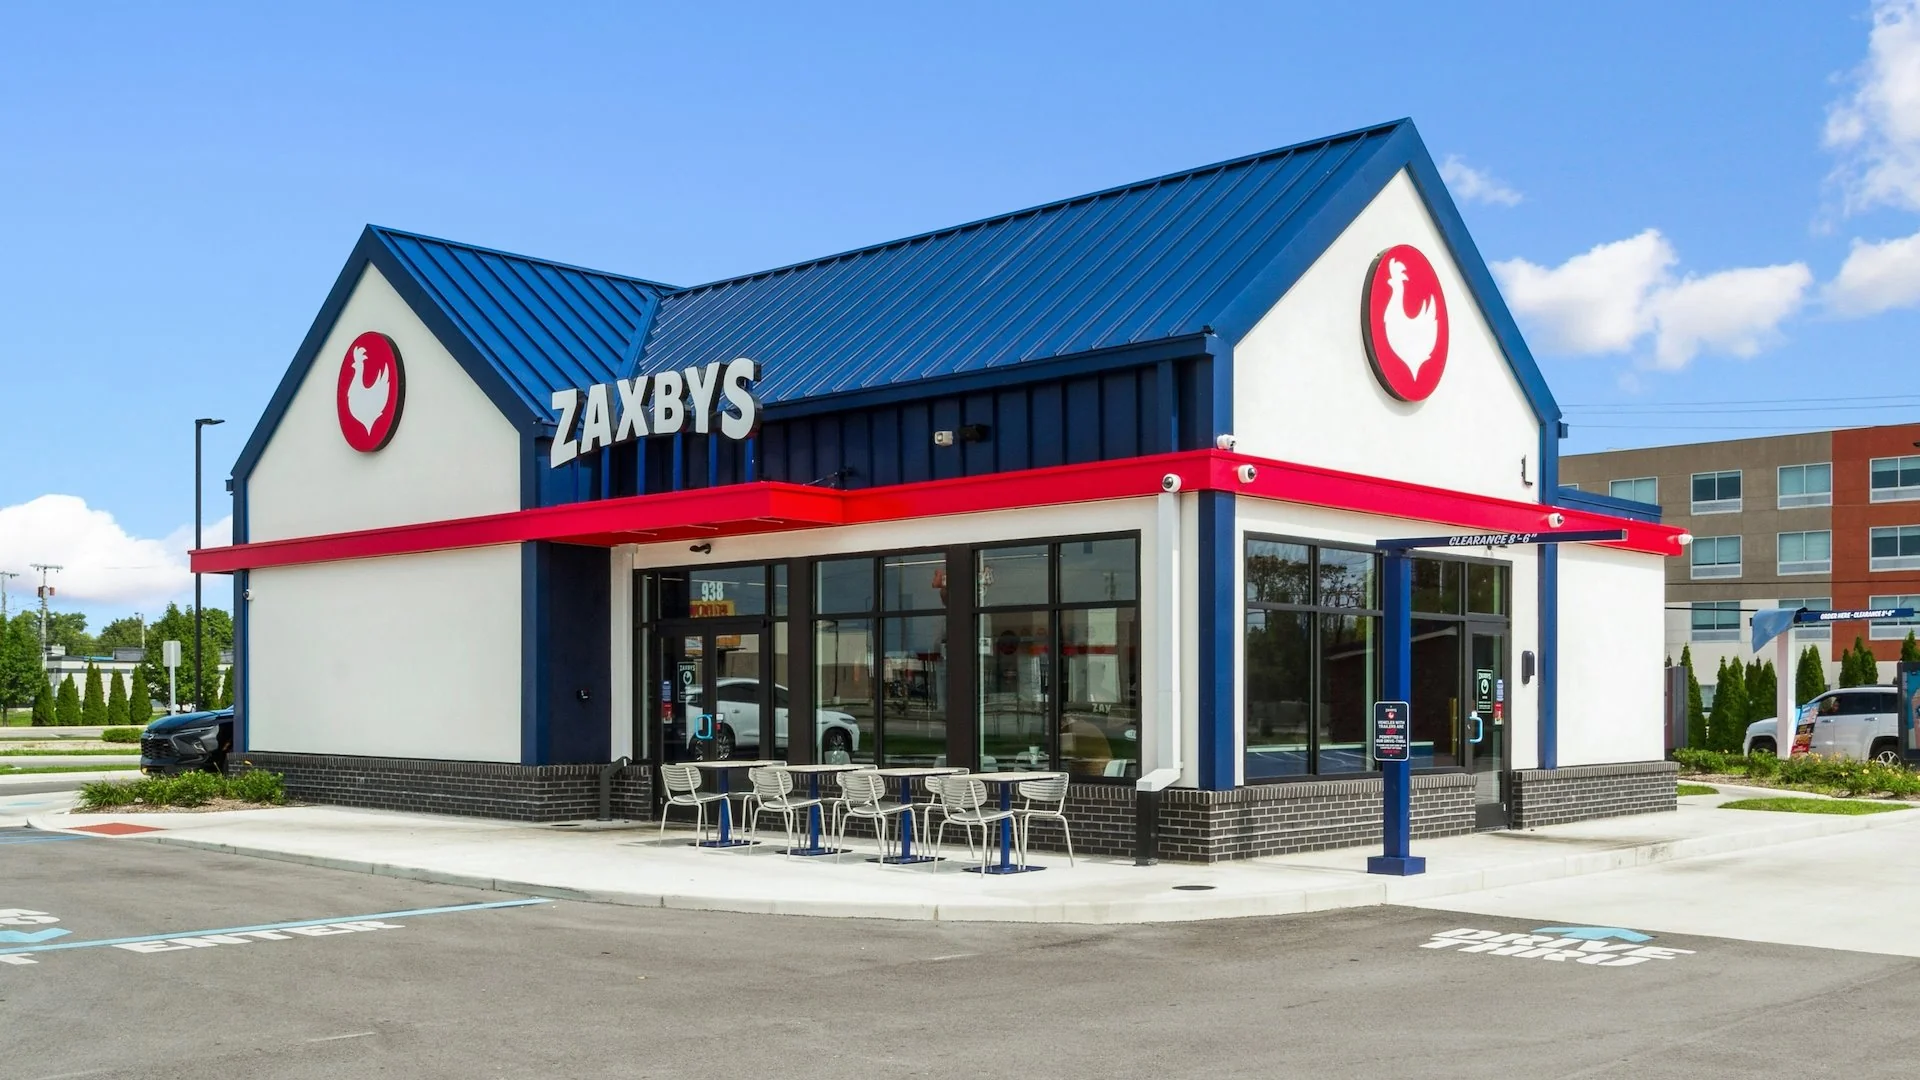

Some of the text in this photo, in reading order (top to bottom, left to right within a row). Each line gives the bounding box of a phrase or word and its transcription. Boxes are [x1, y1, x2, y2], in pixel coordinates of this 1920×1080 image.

[550, 357, 756, 469] ZAXBYS
[1448, 534, 1508, 546] CLEARANCE
[701, 581, 724, 602] 938
[1820, 612, 1837, 620] ORDER
[1854, 610, 1881, 618] CLEARANCE
[1091, 703, 1111, 713] ZAX
[112, 920, 405, 954] ENTER
[1431, 927, 1697, 960] DRIVE
[1418, 937, 1651, 966] THRU
